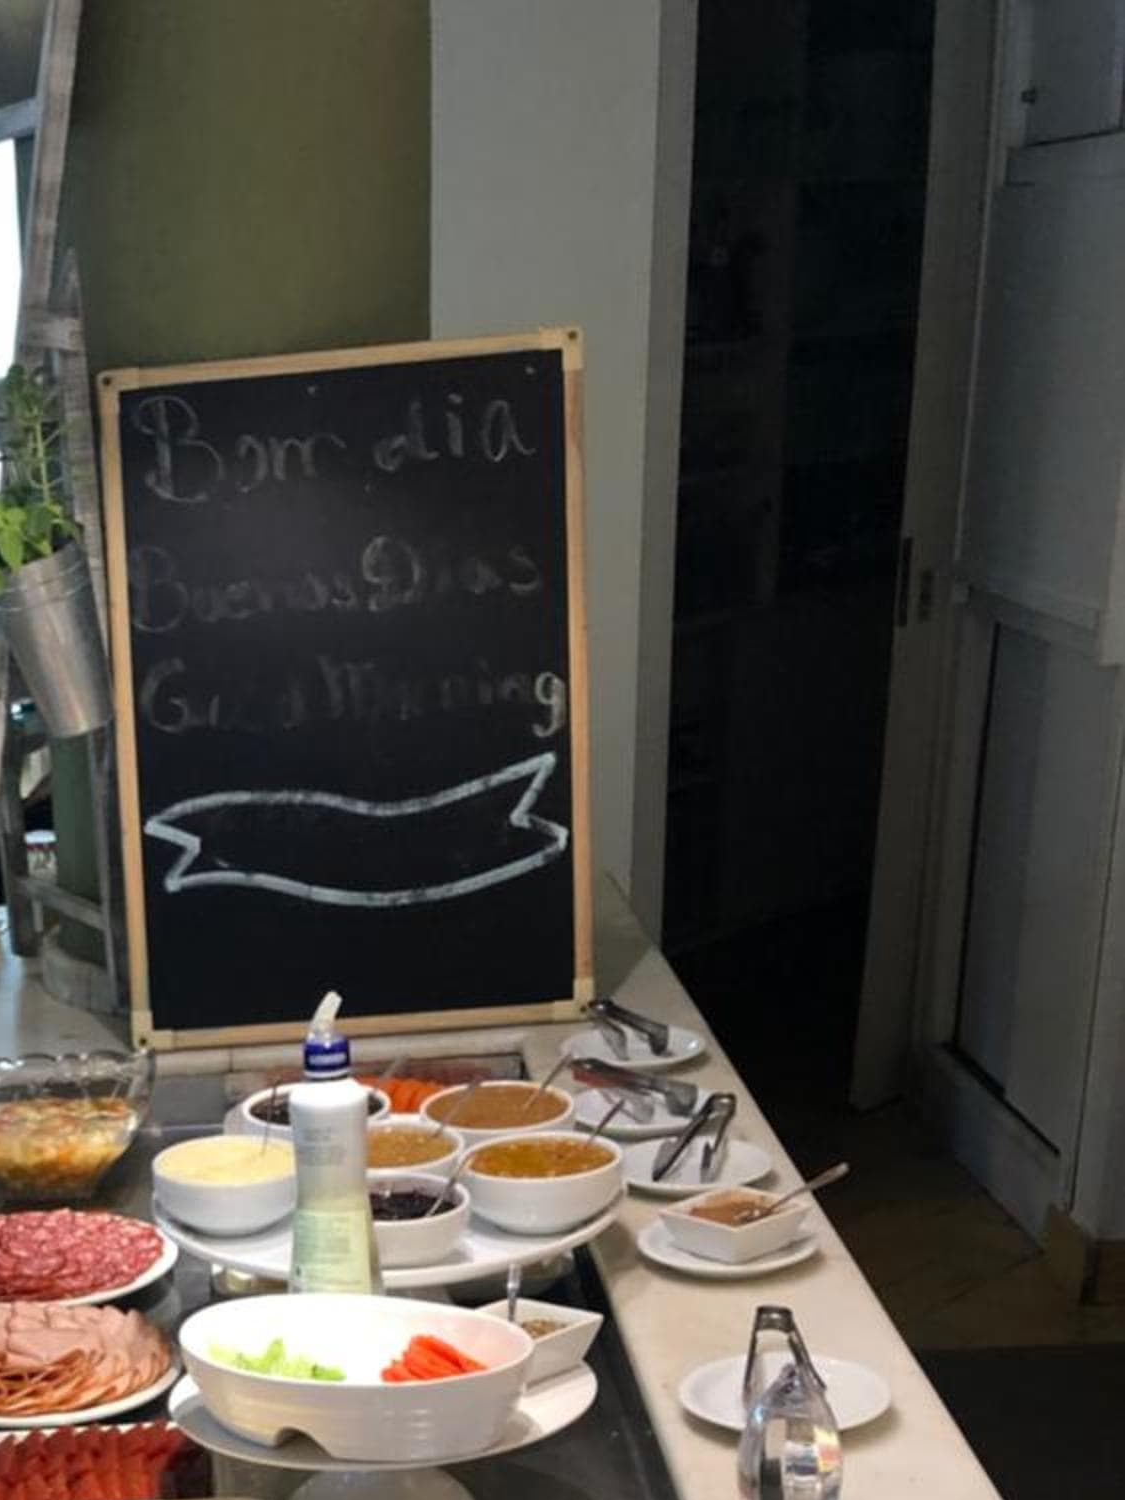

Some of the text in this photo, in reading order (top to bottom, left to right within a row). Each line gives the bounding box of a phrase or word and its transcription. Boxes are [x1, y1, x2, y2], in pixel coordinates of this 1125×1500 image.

[132, 392, 537, 504] Bom dia
[139, 656, 307, 734] Gd
